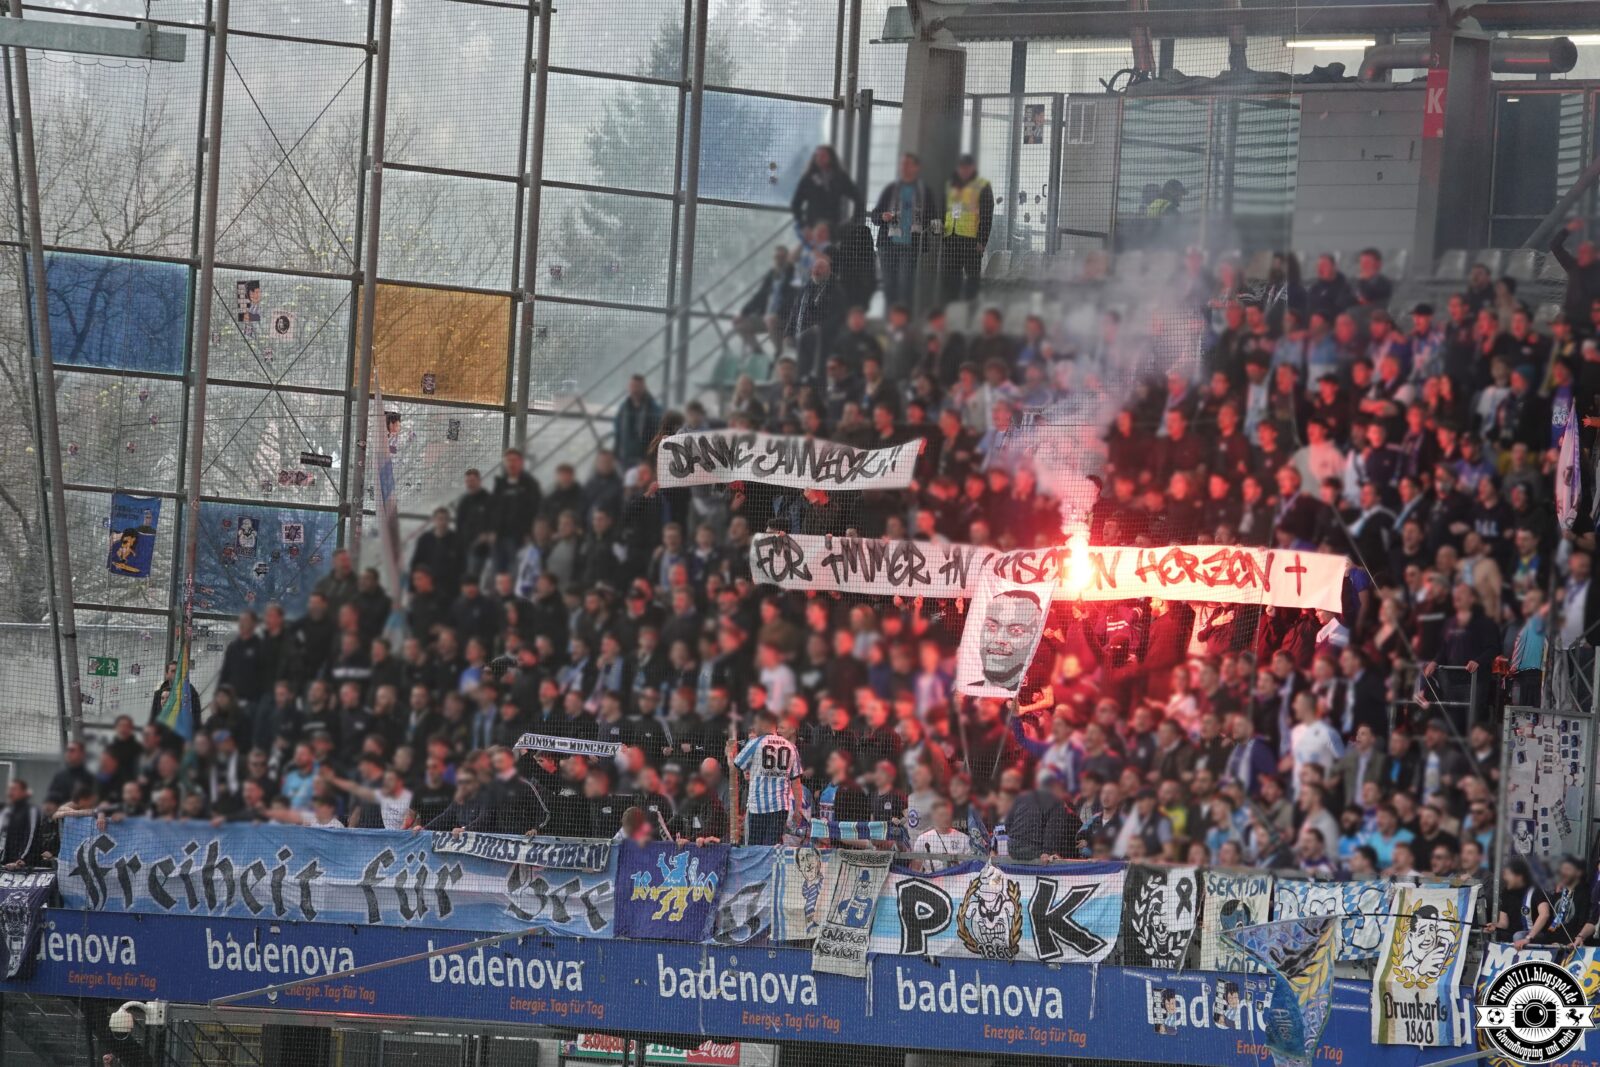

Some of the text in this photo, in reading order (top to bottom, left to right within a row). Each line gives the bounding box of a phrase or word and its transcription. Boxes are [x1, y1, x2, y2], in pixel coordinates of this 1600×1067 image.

[1428, 88, 1444, 113] K
[762, 745, 791, 770] 60
[1208, 874, 1267, 898] SEKTION
[36, 932, 136, 965] enova
[206, 928, 356, 977] badenova
[428, 940, 585, 991] badenova
[107, 973, 122, 989] Tag
[140, 974, 157, 992] Tag
[658, 954, 818, 1006] badenova
[325, 985, 340, 1001] Tag
[359, 987, 375, 1004] Tag
[896, 966, 1064, 1019] badenova
[550, 999, 568, 1016] Tag
[587, 1001, 604, 1019] Tag
[784, 1013, 802, 1031] Tag
[822, 1015, 841, 1034] Tag
[1405, 1020, 1434, 1044] 1860
[1028, 1026, 1047, 1046] Tag
[1068, 1029, 1087, 1048] Tag
[1324, 1045, 1343, 1064] Tag
